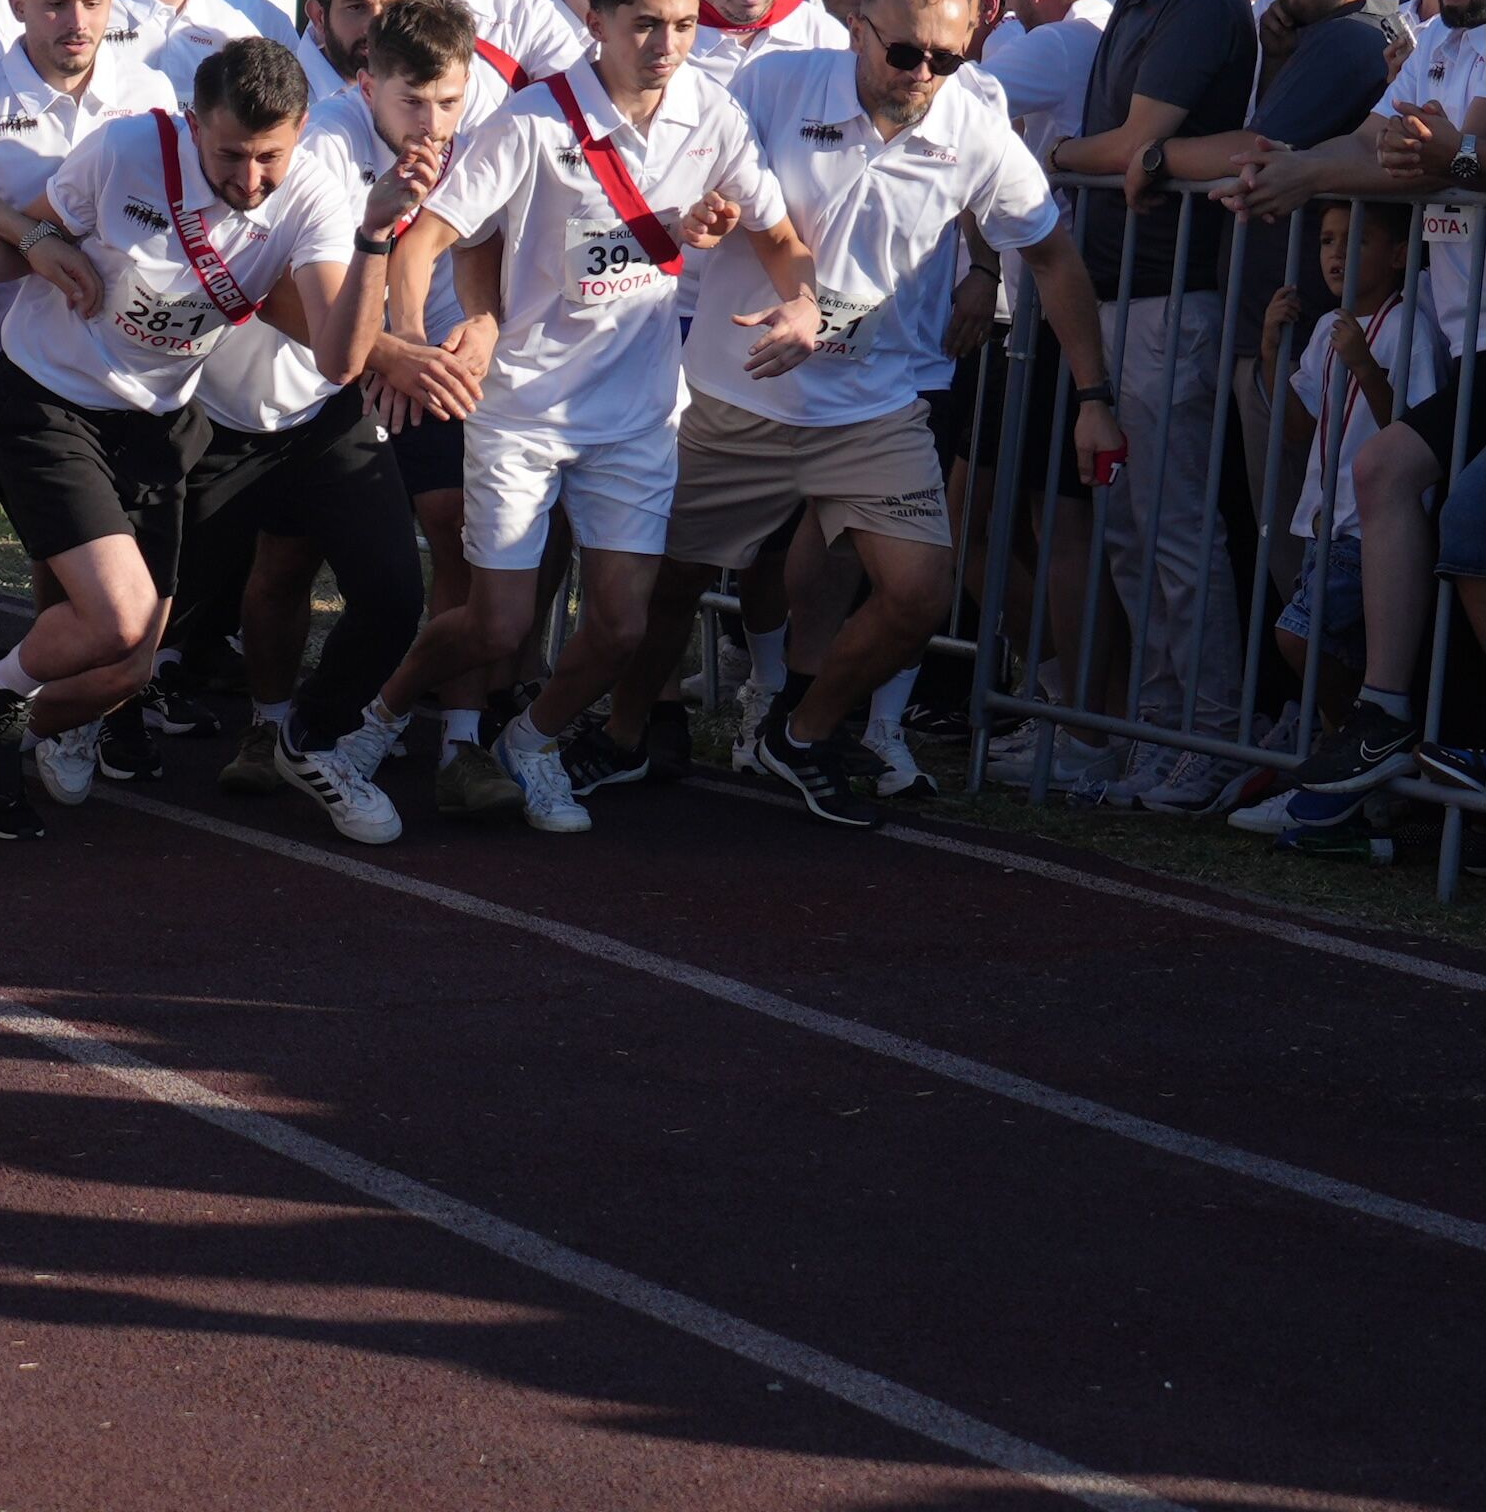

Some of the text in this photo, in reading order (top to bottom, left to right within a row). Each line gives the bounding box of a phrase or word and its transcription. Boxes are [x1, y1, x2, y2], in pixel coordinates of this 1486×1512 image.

[190, 35, 213, 46] TOYOTA
[923, 149, 957, 163] TOYOTA
[609, 230, 634, 239] EKID
[1462, 223, 1468, 235] 1
[587, 245, 649, 275] 39-
[579, 272, 651, 296] TOYOTA
[156, 299, 198, 309] EKIDEN
[817, 295, 857, 311] EKIDEN
[125, 300, 206, 336] 28-1
[115, 311, 192, 351] TOYOTA
[813, 340, 851, 355] OTA
